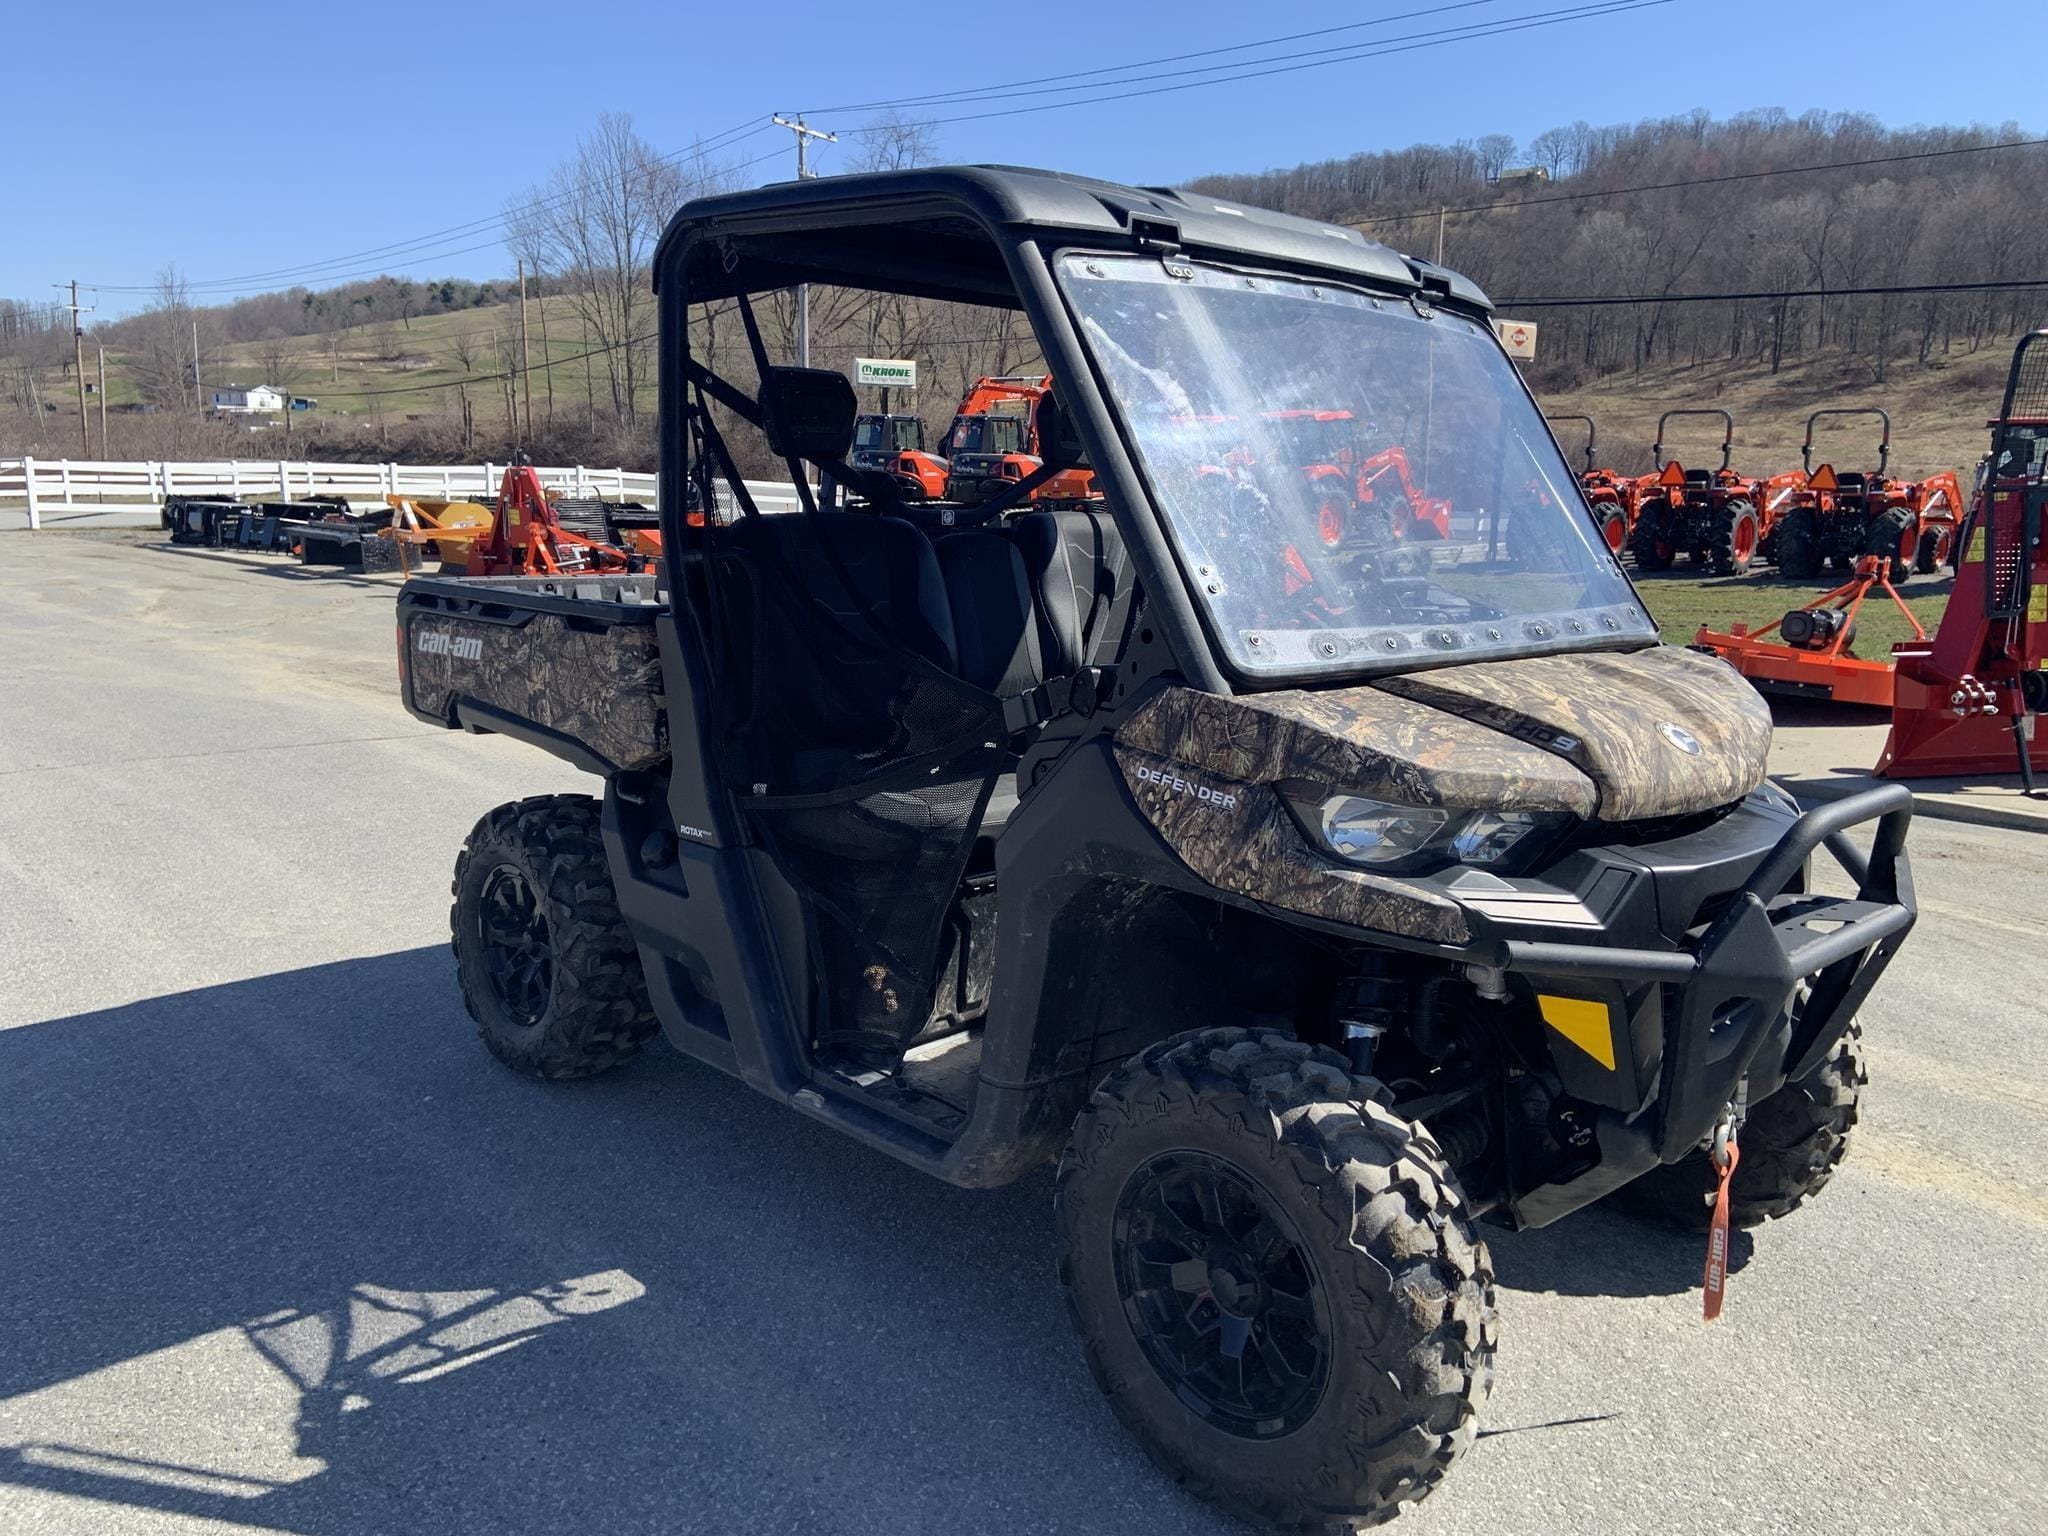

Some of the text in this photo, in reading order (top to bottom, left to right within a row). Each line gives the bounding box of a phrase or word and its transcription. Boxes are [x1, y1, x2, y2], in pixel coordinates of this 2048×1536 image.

[872, 367, 912, 377] KRONE
[418, 631, 483, 660] can-am
[1137, 766, 1237, 809] DEFENDER
[680, 824, 704, 839] ROTAX
[1708, 1228, 1724, 1293] can-am
